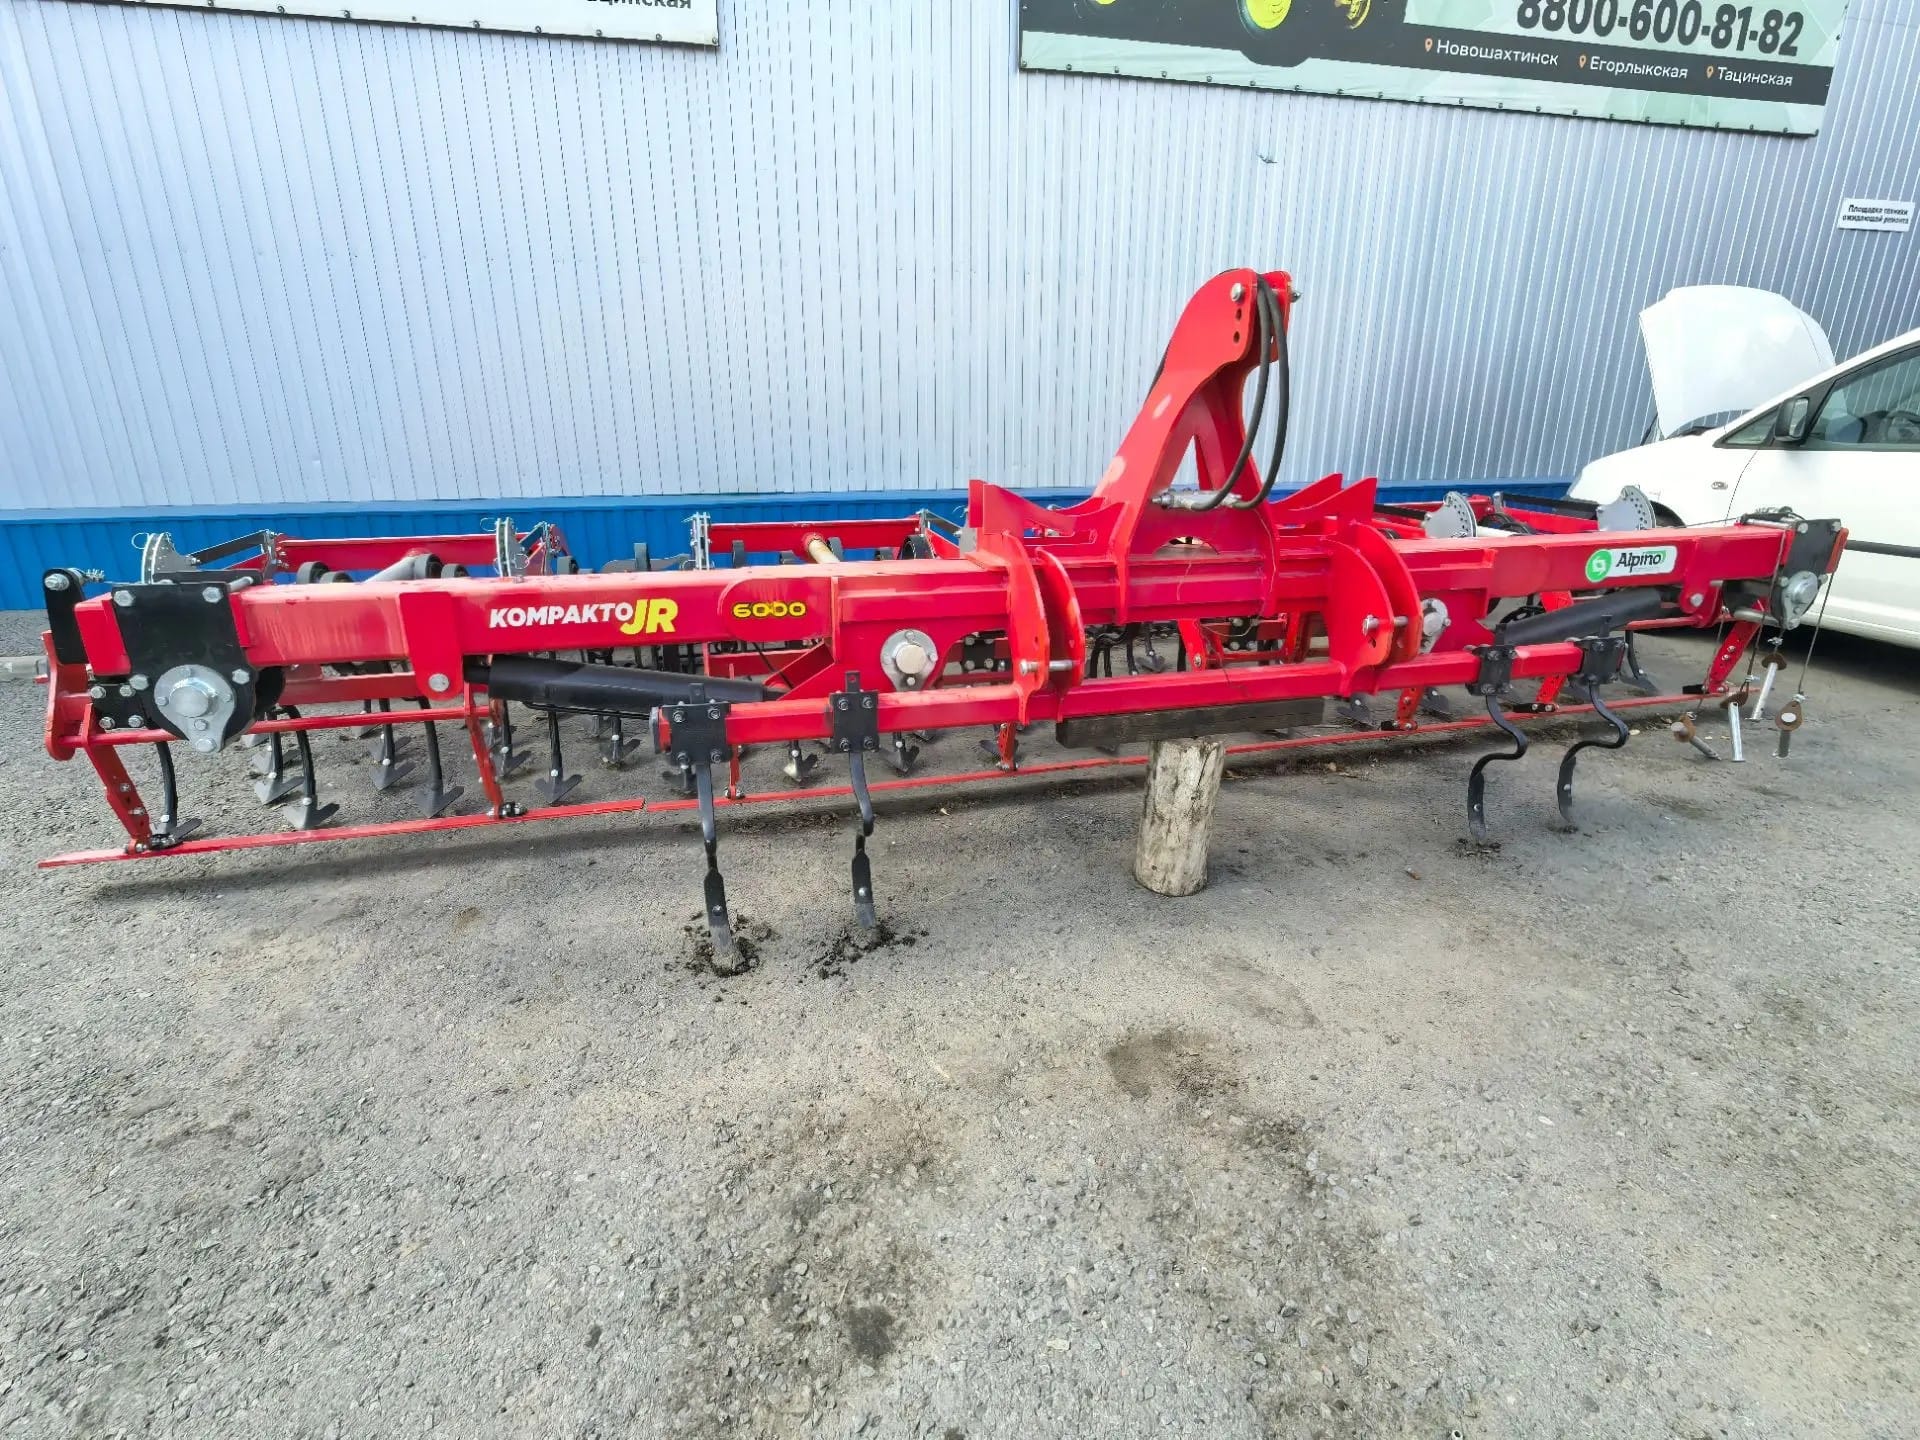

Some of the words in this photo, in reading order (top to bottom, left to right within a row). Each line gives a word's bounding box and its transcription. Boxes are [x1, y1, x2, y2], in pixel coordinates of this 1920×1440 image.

[1516, 0, 1804, 57] 8800-600-81-82
[1436, 39, 1559, 66] Новошахтинск
[1589, 56, 1689, 79] Егорлыкская
[1717, 66, 1793, 86] Тацинская
[1615, 552, 1662, 573] Alpino
[732, 601, 807, 618] 6000
